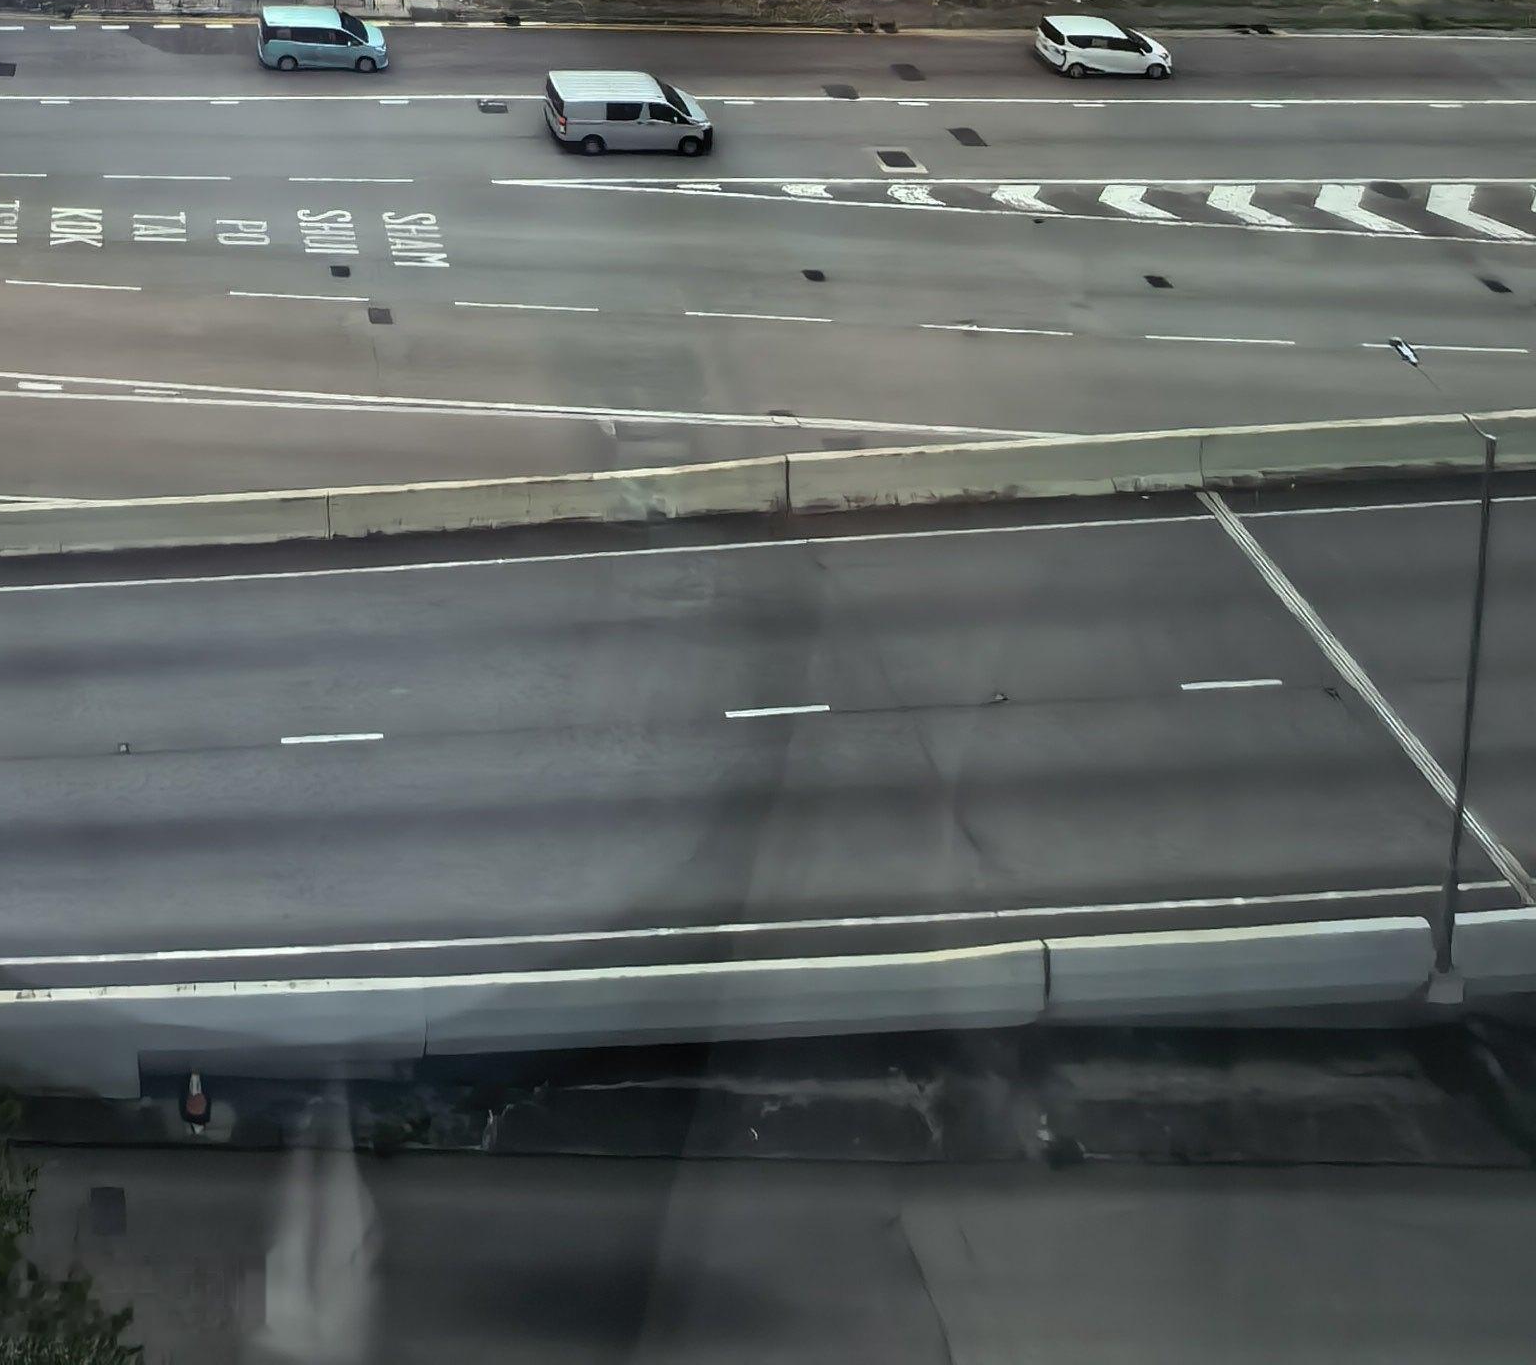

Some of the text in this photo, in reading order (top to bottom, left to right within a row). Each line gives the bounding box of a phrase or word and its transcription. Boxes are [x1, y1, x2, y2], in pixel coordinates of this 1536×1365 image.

[49, 207, 103, 247] KOK
[132, 211, 187, 243] TAI
[216, 219, 270, 246] PO
[297, 209, 360, 255] SHUI
[382, 211, 450, 268] SHAM
